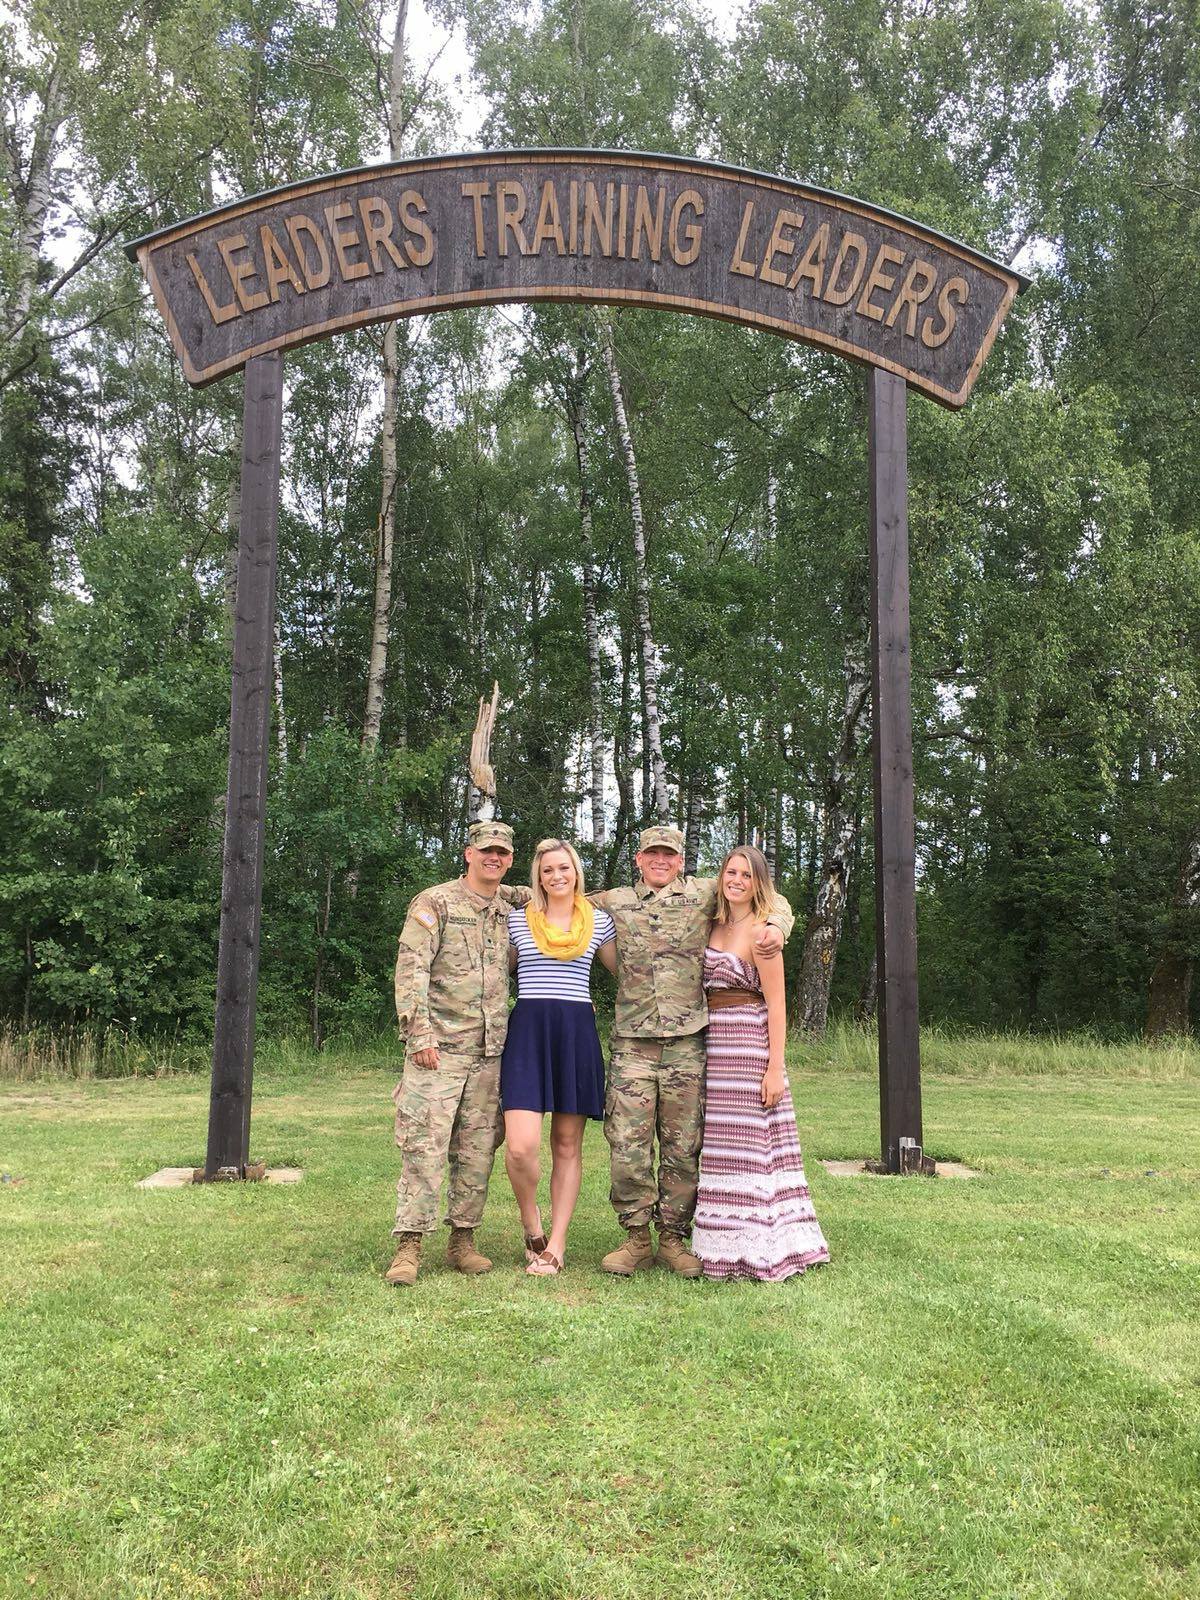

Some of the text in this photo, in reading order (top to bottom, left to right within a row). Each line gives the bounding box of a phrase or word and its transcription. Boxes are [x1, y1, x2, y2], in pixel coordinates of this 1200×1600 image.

[186, 181, 970, 350] LEADERS TRAINING LEADERS
